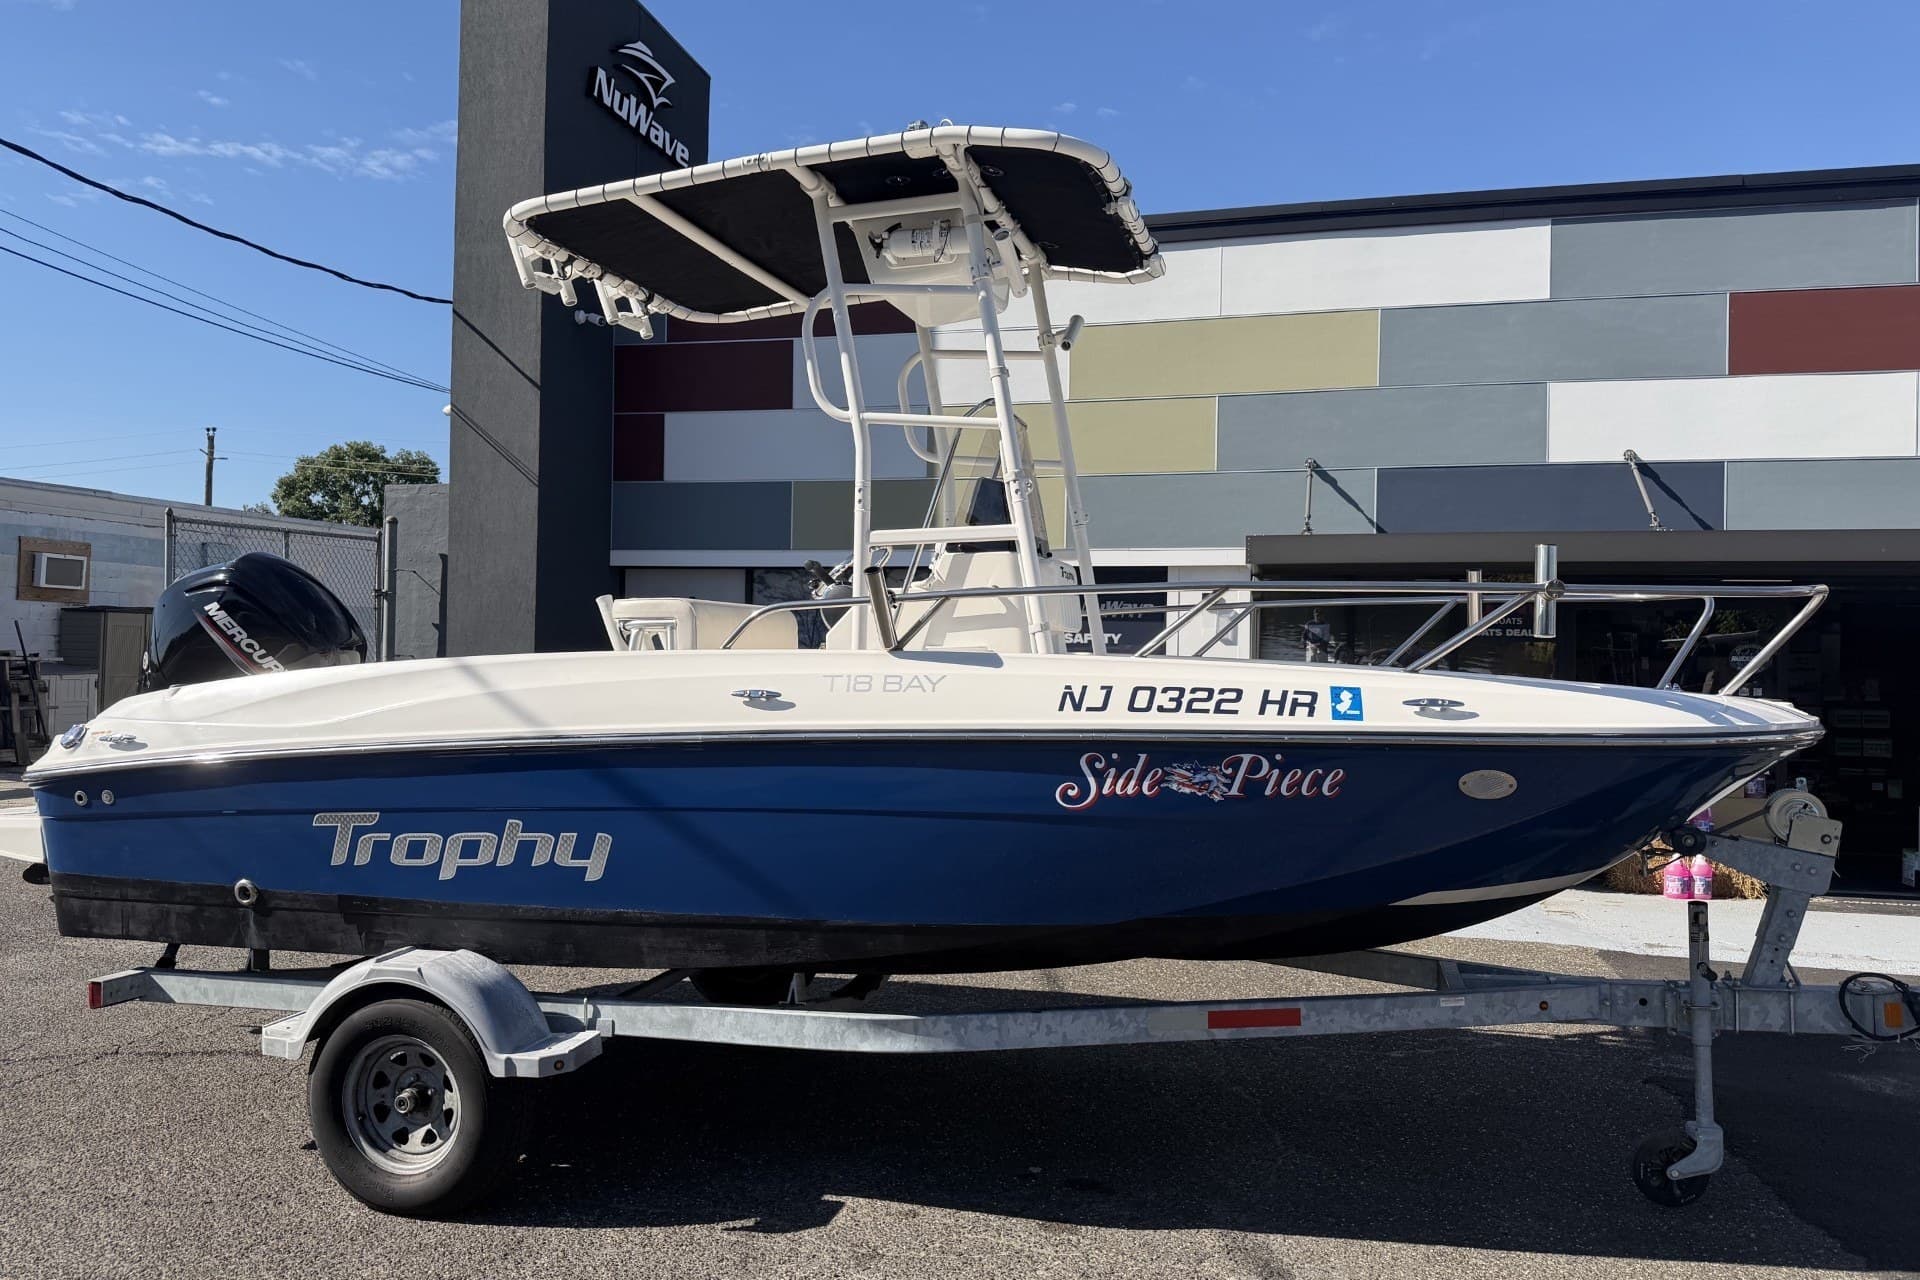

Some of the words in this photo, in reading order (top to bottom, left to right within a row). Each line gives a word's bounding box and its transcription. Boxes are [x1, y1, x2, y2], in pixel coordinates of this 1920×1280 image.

[593, 66, 690, 168] NuWave
[203, 601, 288, 672] MERCUR
[1497, 617, 1524, 625] OATS
[1505, 628, 1535, 637] DEAL
[1064, 633, 1122, 645] SAFTY
[822, 674, 873, 693] T18
[882, 674, 947, 693] BAY
[1058, 685, 1114, 712] NJ
[1127, 685, 1244, 715] 0322
[1258, 689, 1319, 718] HR
[1055, 752, 1164, 811] Side
[1221, 753, 1347, 799] Piece
[312, 812, 612, 881] Trophy
